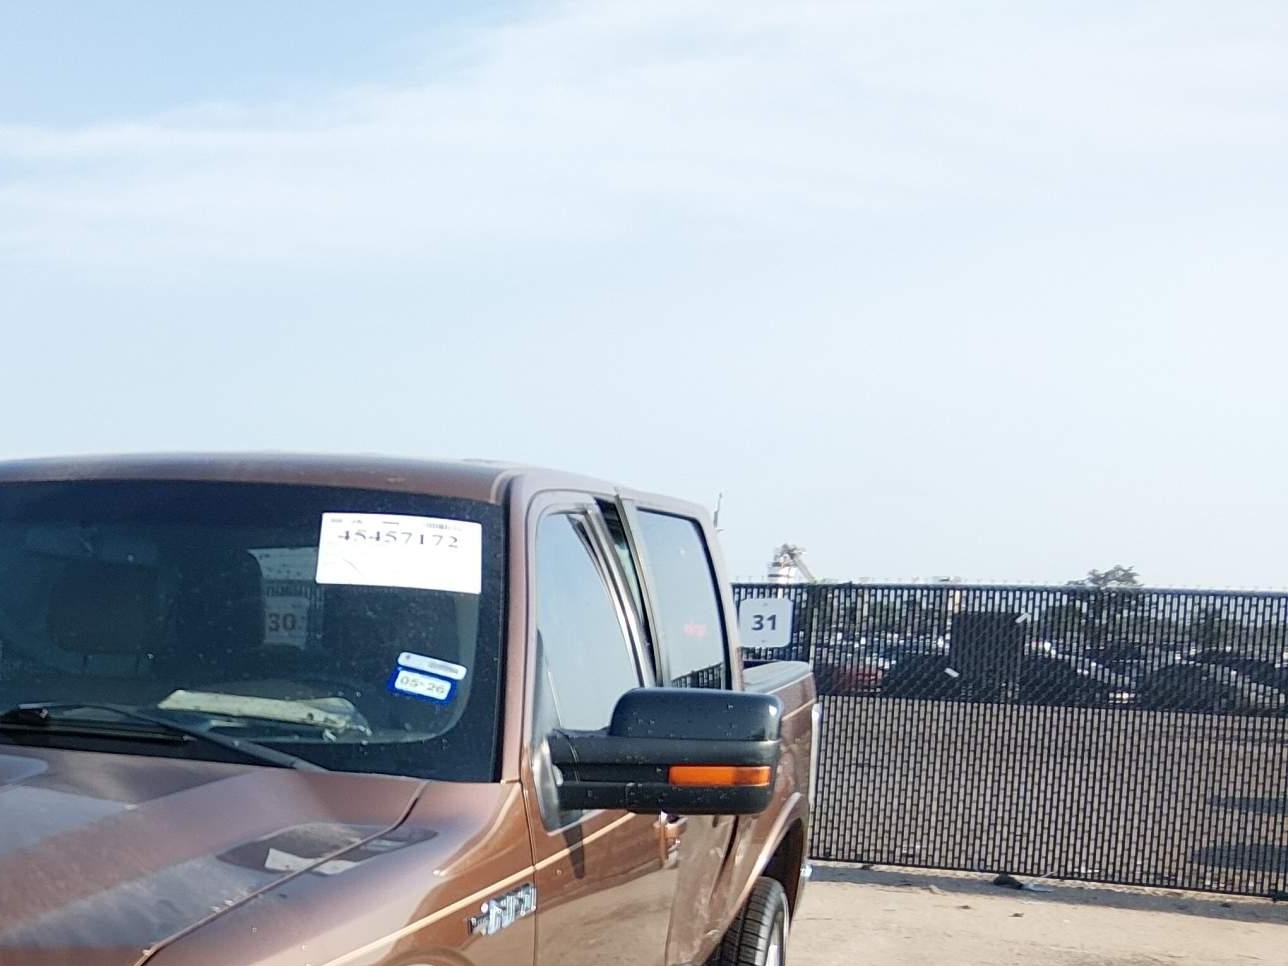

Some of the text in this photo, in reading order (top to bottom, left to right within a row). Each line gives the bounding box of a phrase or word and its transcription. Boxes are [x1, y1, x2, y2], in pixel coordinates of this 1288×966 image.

[338, 529, 459, 549] 45457172
[268, 612, 296, 632] 30
[752, 614, 776, 631] 31
